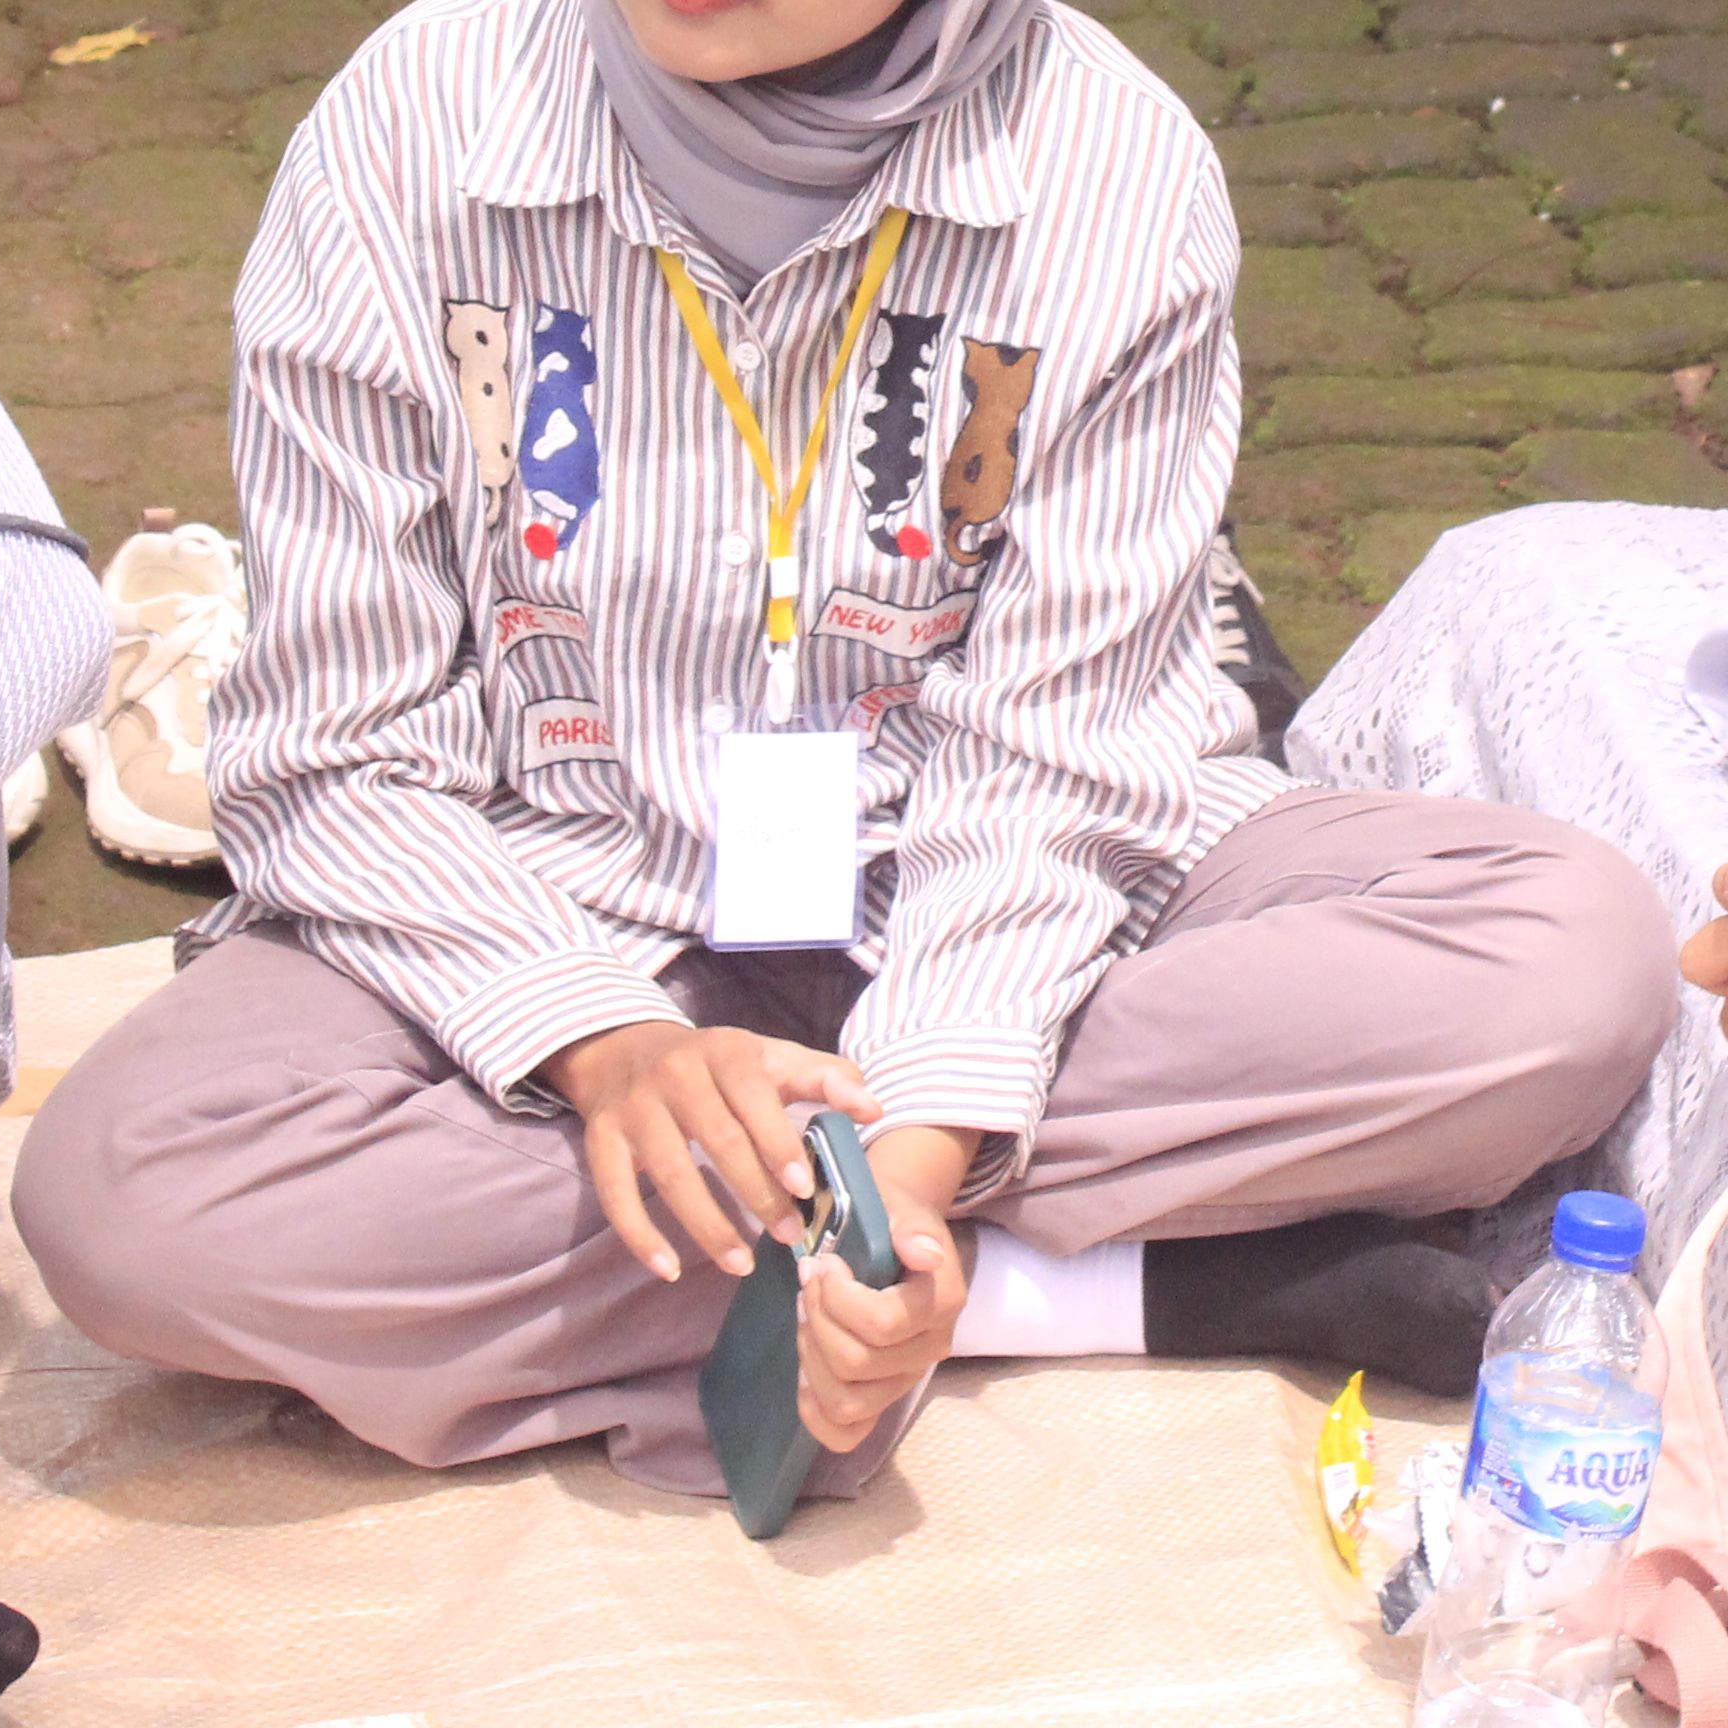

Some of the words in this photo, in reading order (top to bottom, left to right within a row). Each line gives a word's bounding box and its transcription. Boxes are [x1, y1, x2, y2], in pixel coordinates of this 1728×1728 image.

[827, 604, 896, 635] NEW
[909, 608, 966, 645] YORK
[1546, 1446, 1649, 1497] AQUA
